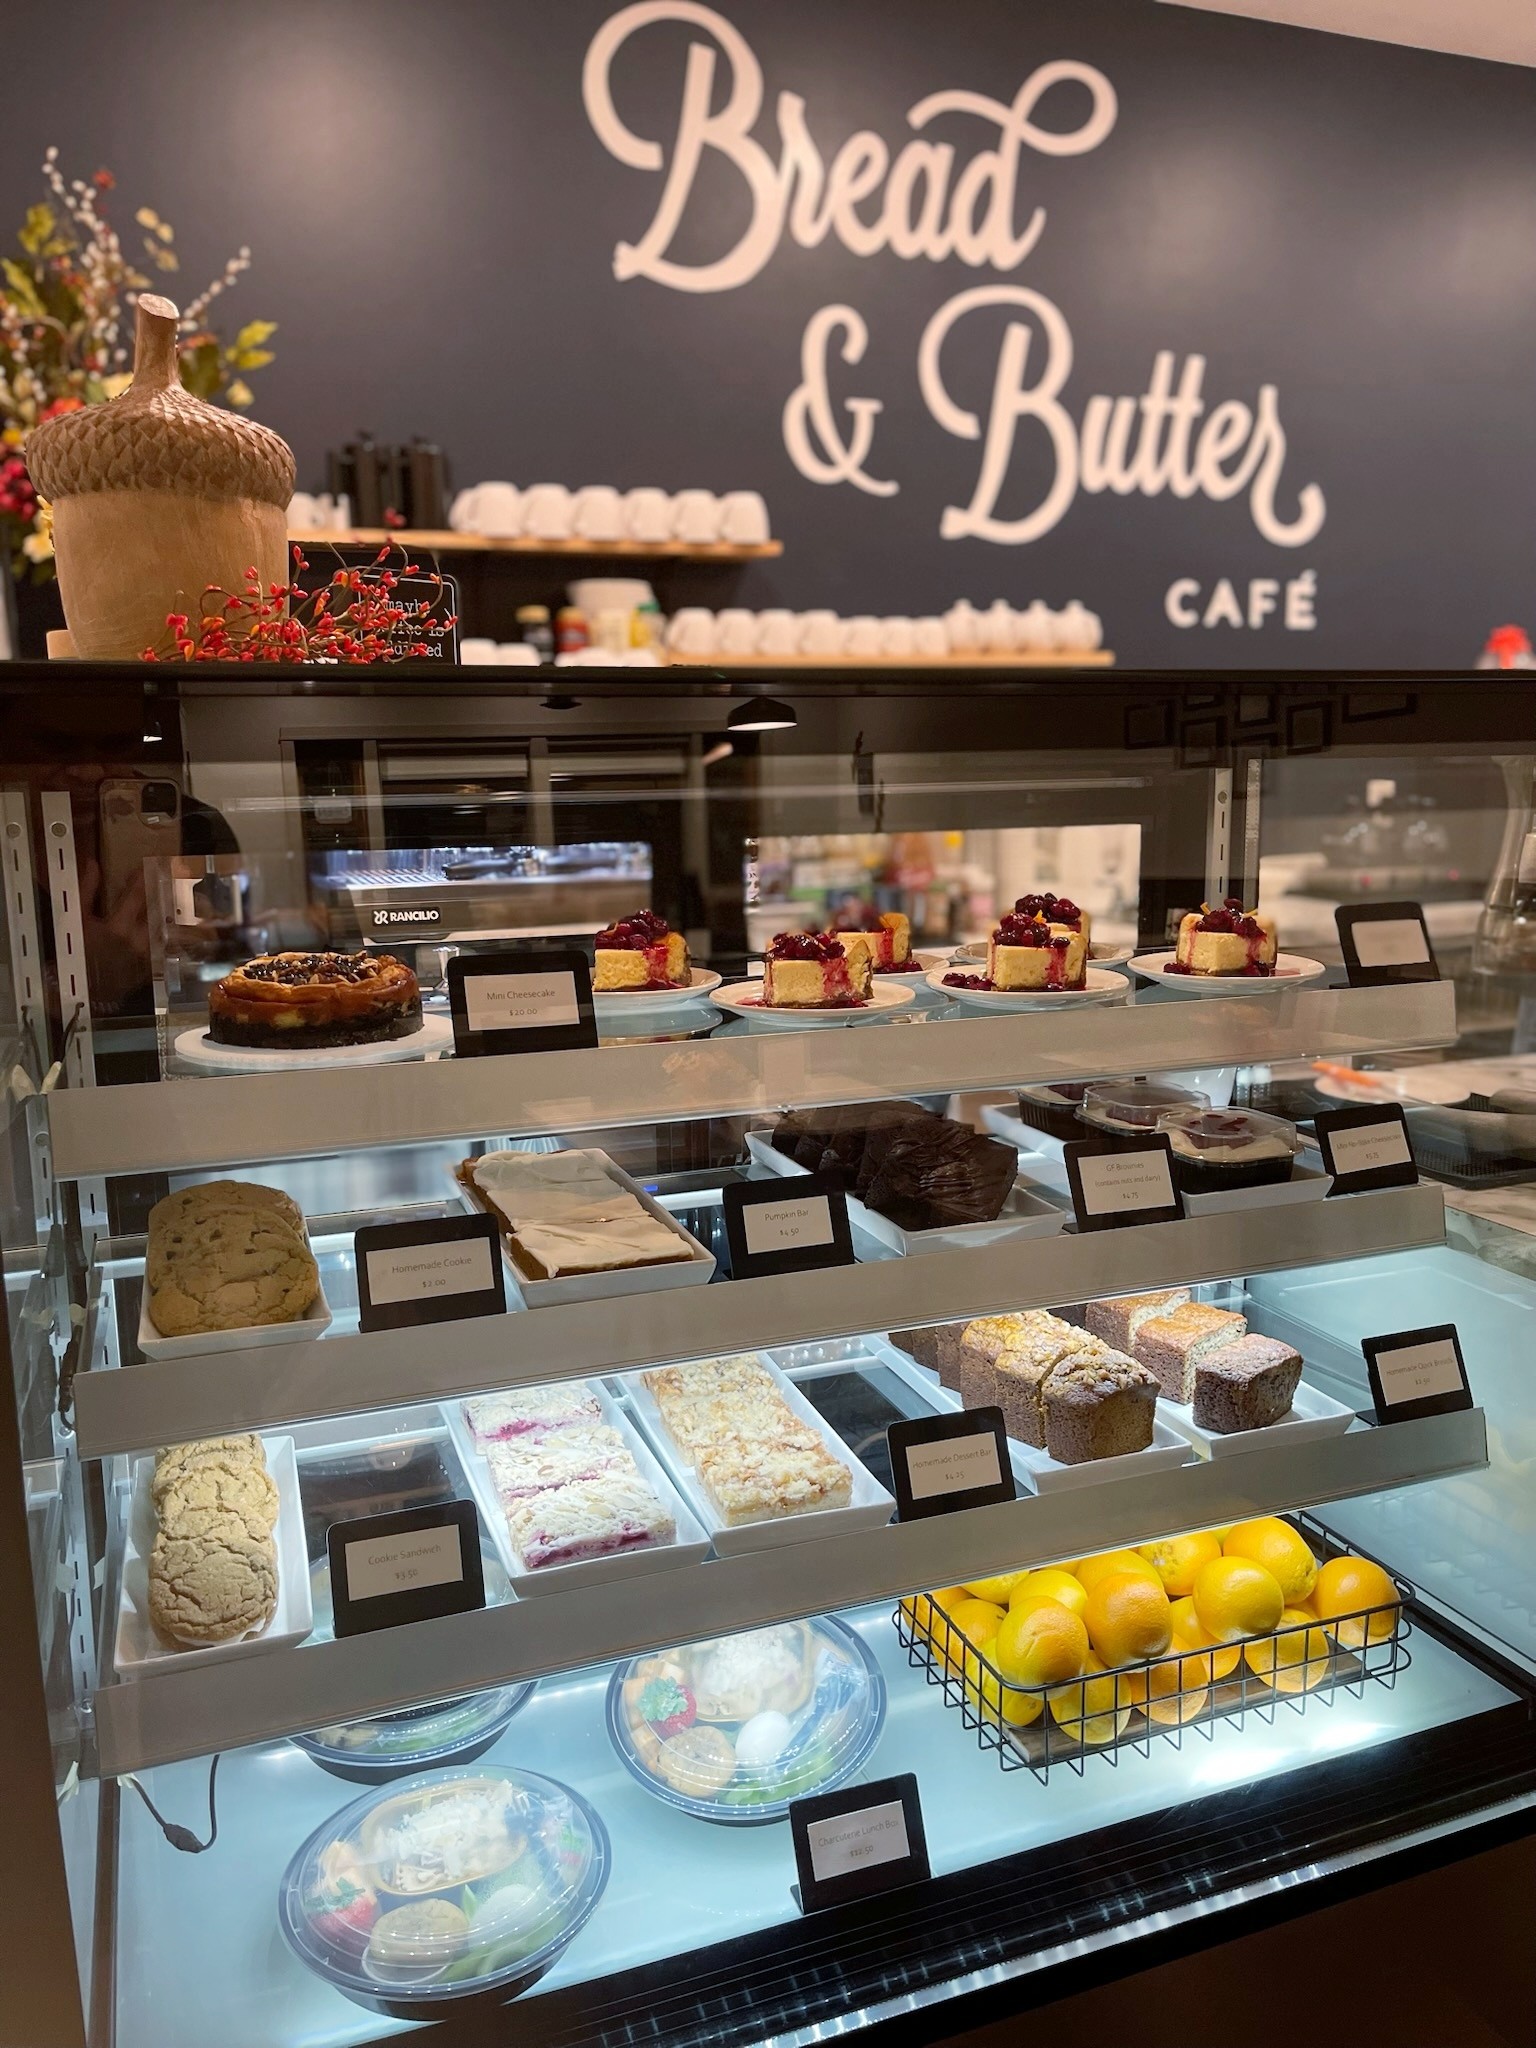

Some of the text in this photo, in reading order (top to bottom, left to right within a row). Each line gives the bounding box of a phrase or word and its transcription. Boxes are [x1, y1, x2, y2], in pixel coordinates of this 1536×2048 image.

[582, 0, 1118, 292] Bread
[782, 284, 1326, 547] & Butter
[1165, 570, 1318, 631] CAFÉ
[389, 910, 440, 922] RANCILIO
[486, 989, 556, 1000] Mini Cheesecake
[1106, 1162, 1145, 1172] GF Brownies
[764, 1209, 809, 1221] Pumpkin Bar
[391, 1257, 472, 1273] Homemade Cookie
[912, 1448, 992, 1469] Homemade Dessert Bar
[368, 1544, 442, 1566] Cookie Sandwich
[818, 1820, 899, 1847] Charcuterie Lunch Box
